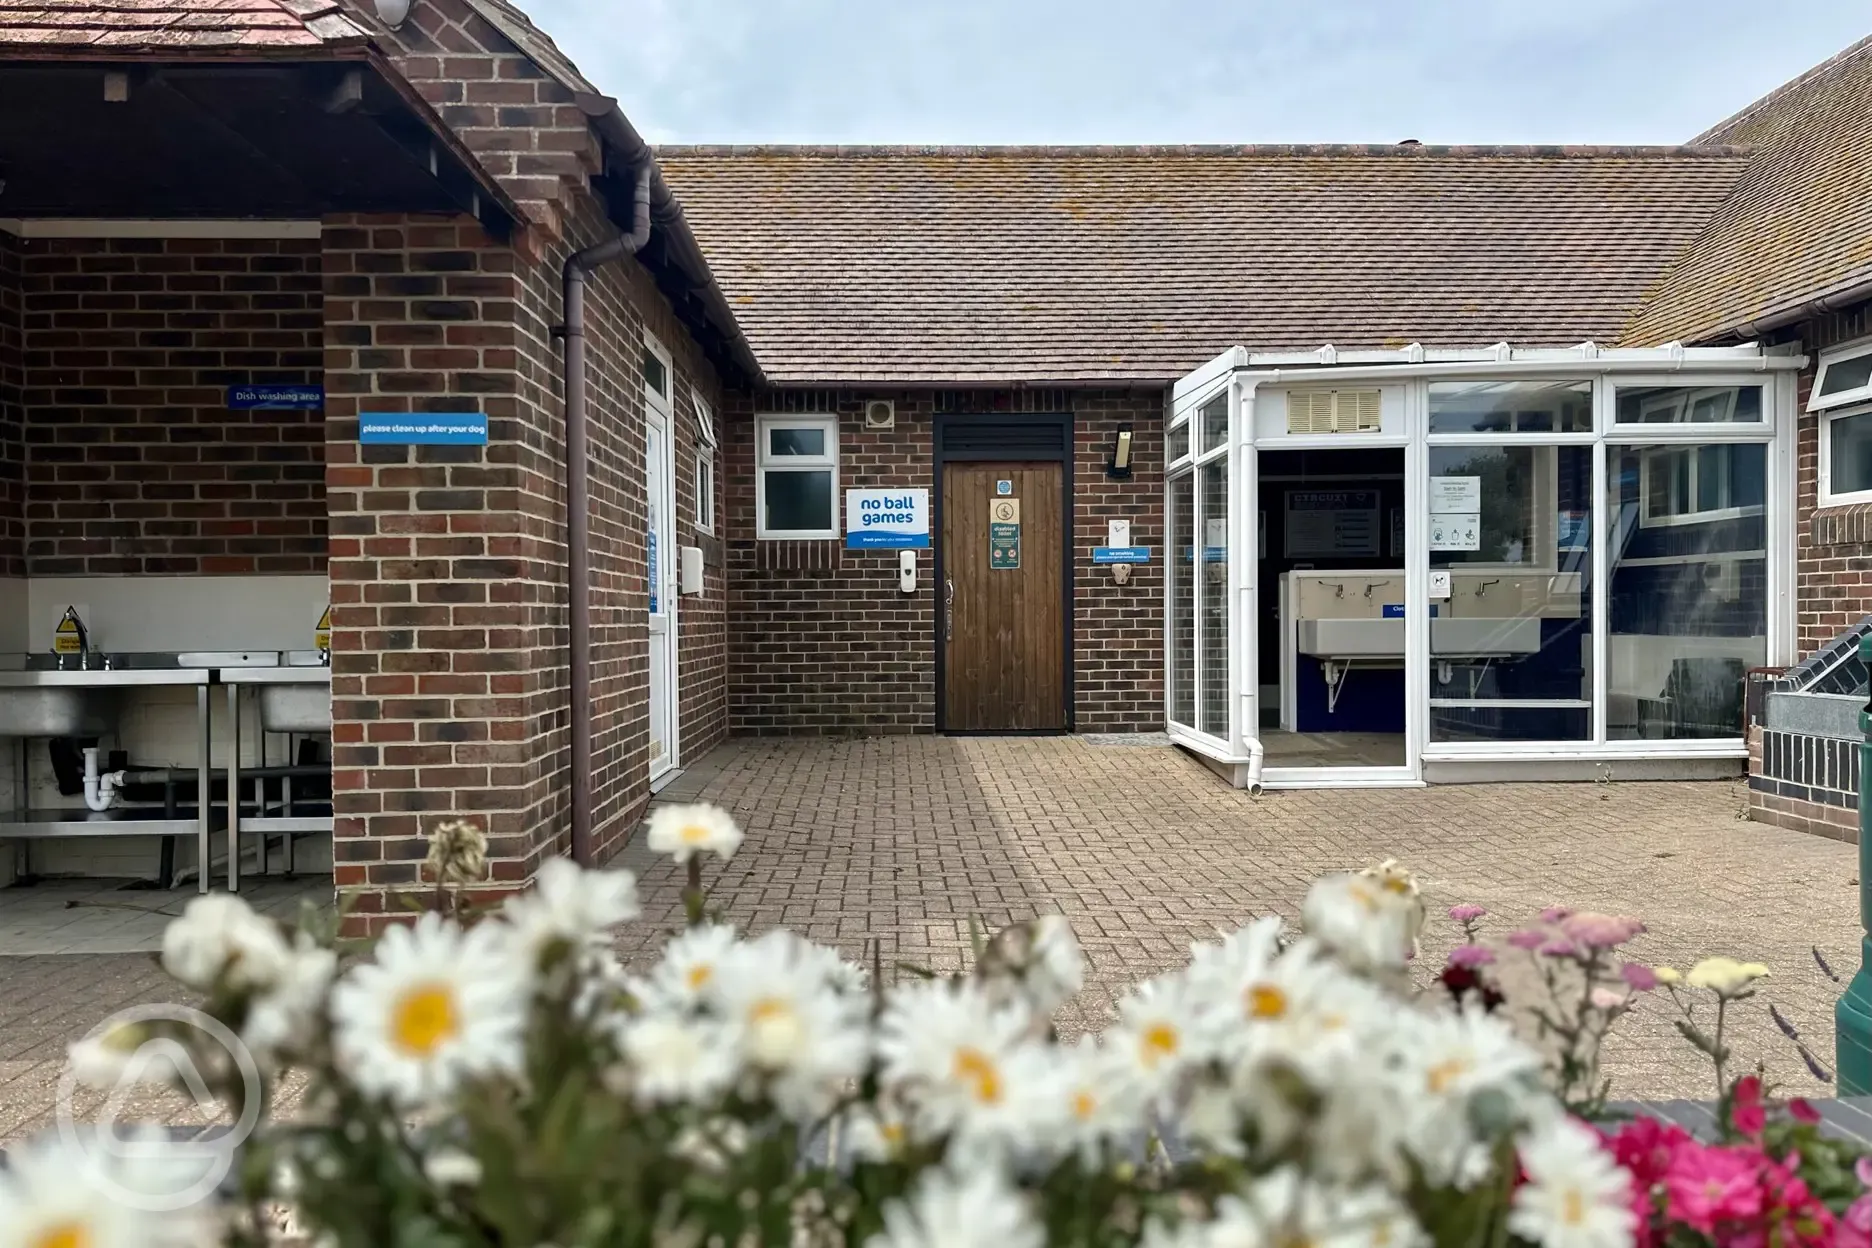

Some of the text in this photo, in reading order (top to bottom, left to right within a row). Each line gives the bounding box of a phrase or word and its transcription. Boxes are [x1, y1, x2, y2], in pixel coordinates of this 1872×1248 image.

[236, 391, 320, 403] Dish washing area
[363, 424, 486, 435] please clean up after your dog
[861, 496, 914, 510] no ball
[862, 513, 914, 527] games
